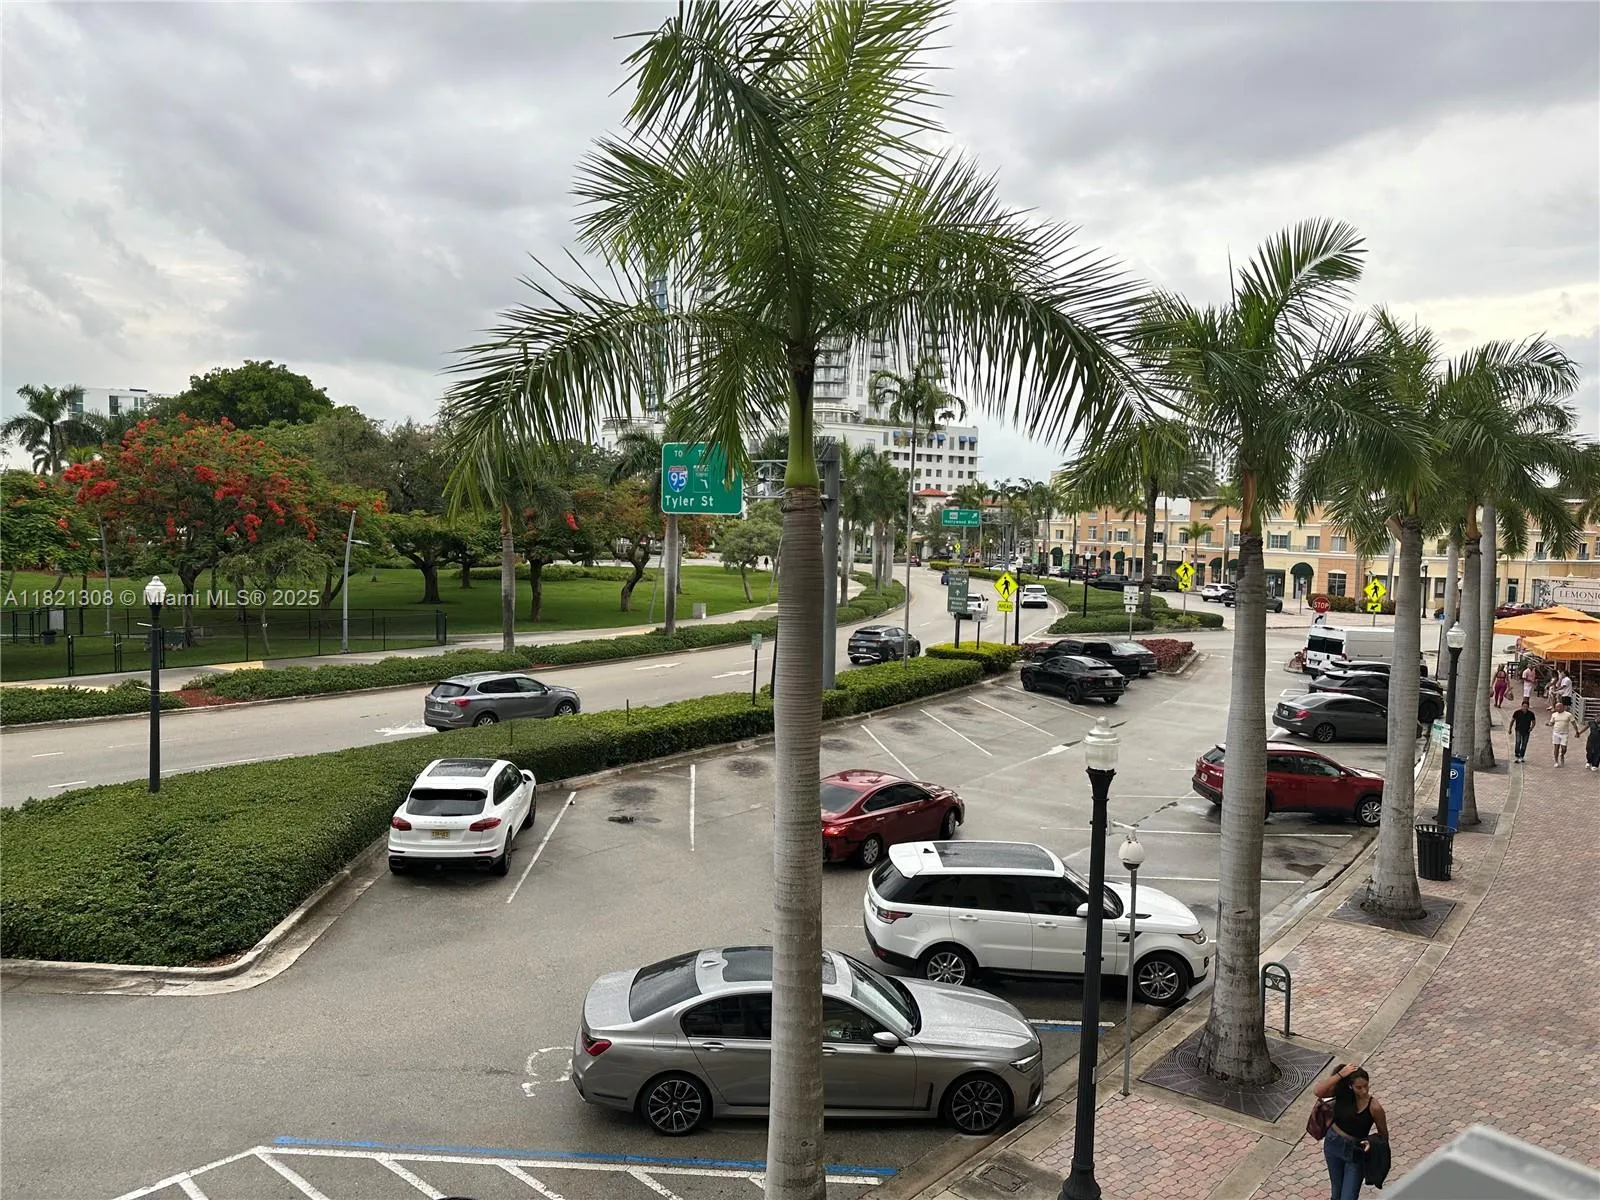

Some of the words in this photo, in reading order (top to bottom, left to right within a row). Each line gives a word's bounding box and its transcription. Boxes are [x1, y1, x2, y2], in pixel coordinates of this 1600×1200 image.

[674, 450, 683, 458] TO
[670, 472, 687, 487] 95
[665, 495, 695, 509] Tyler
[701, 495, 714, 507] St
[1314, 601, 1330, 609] STOP
